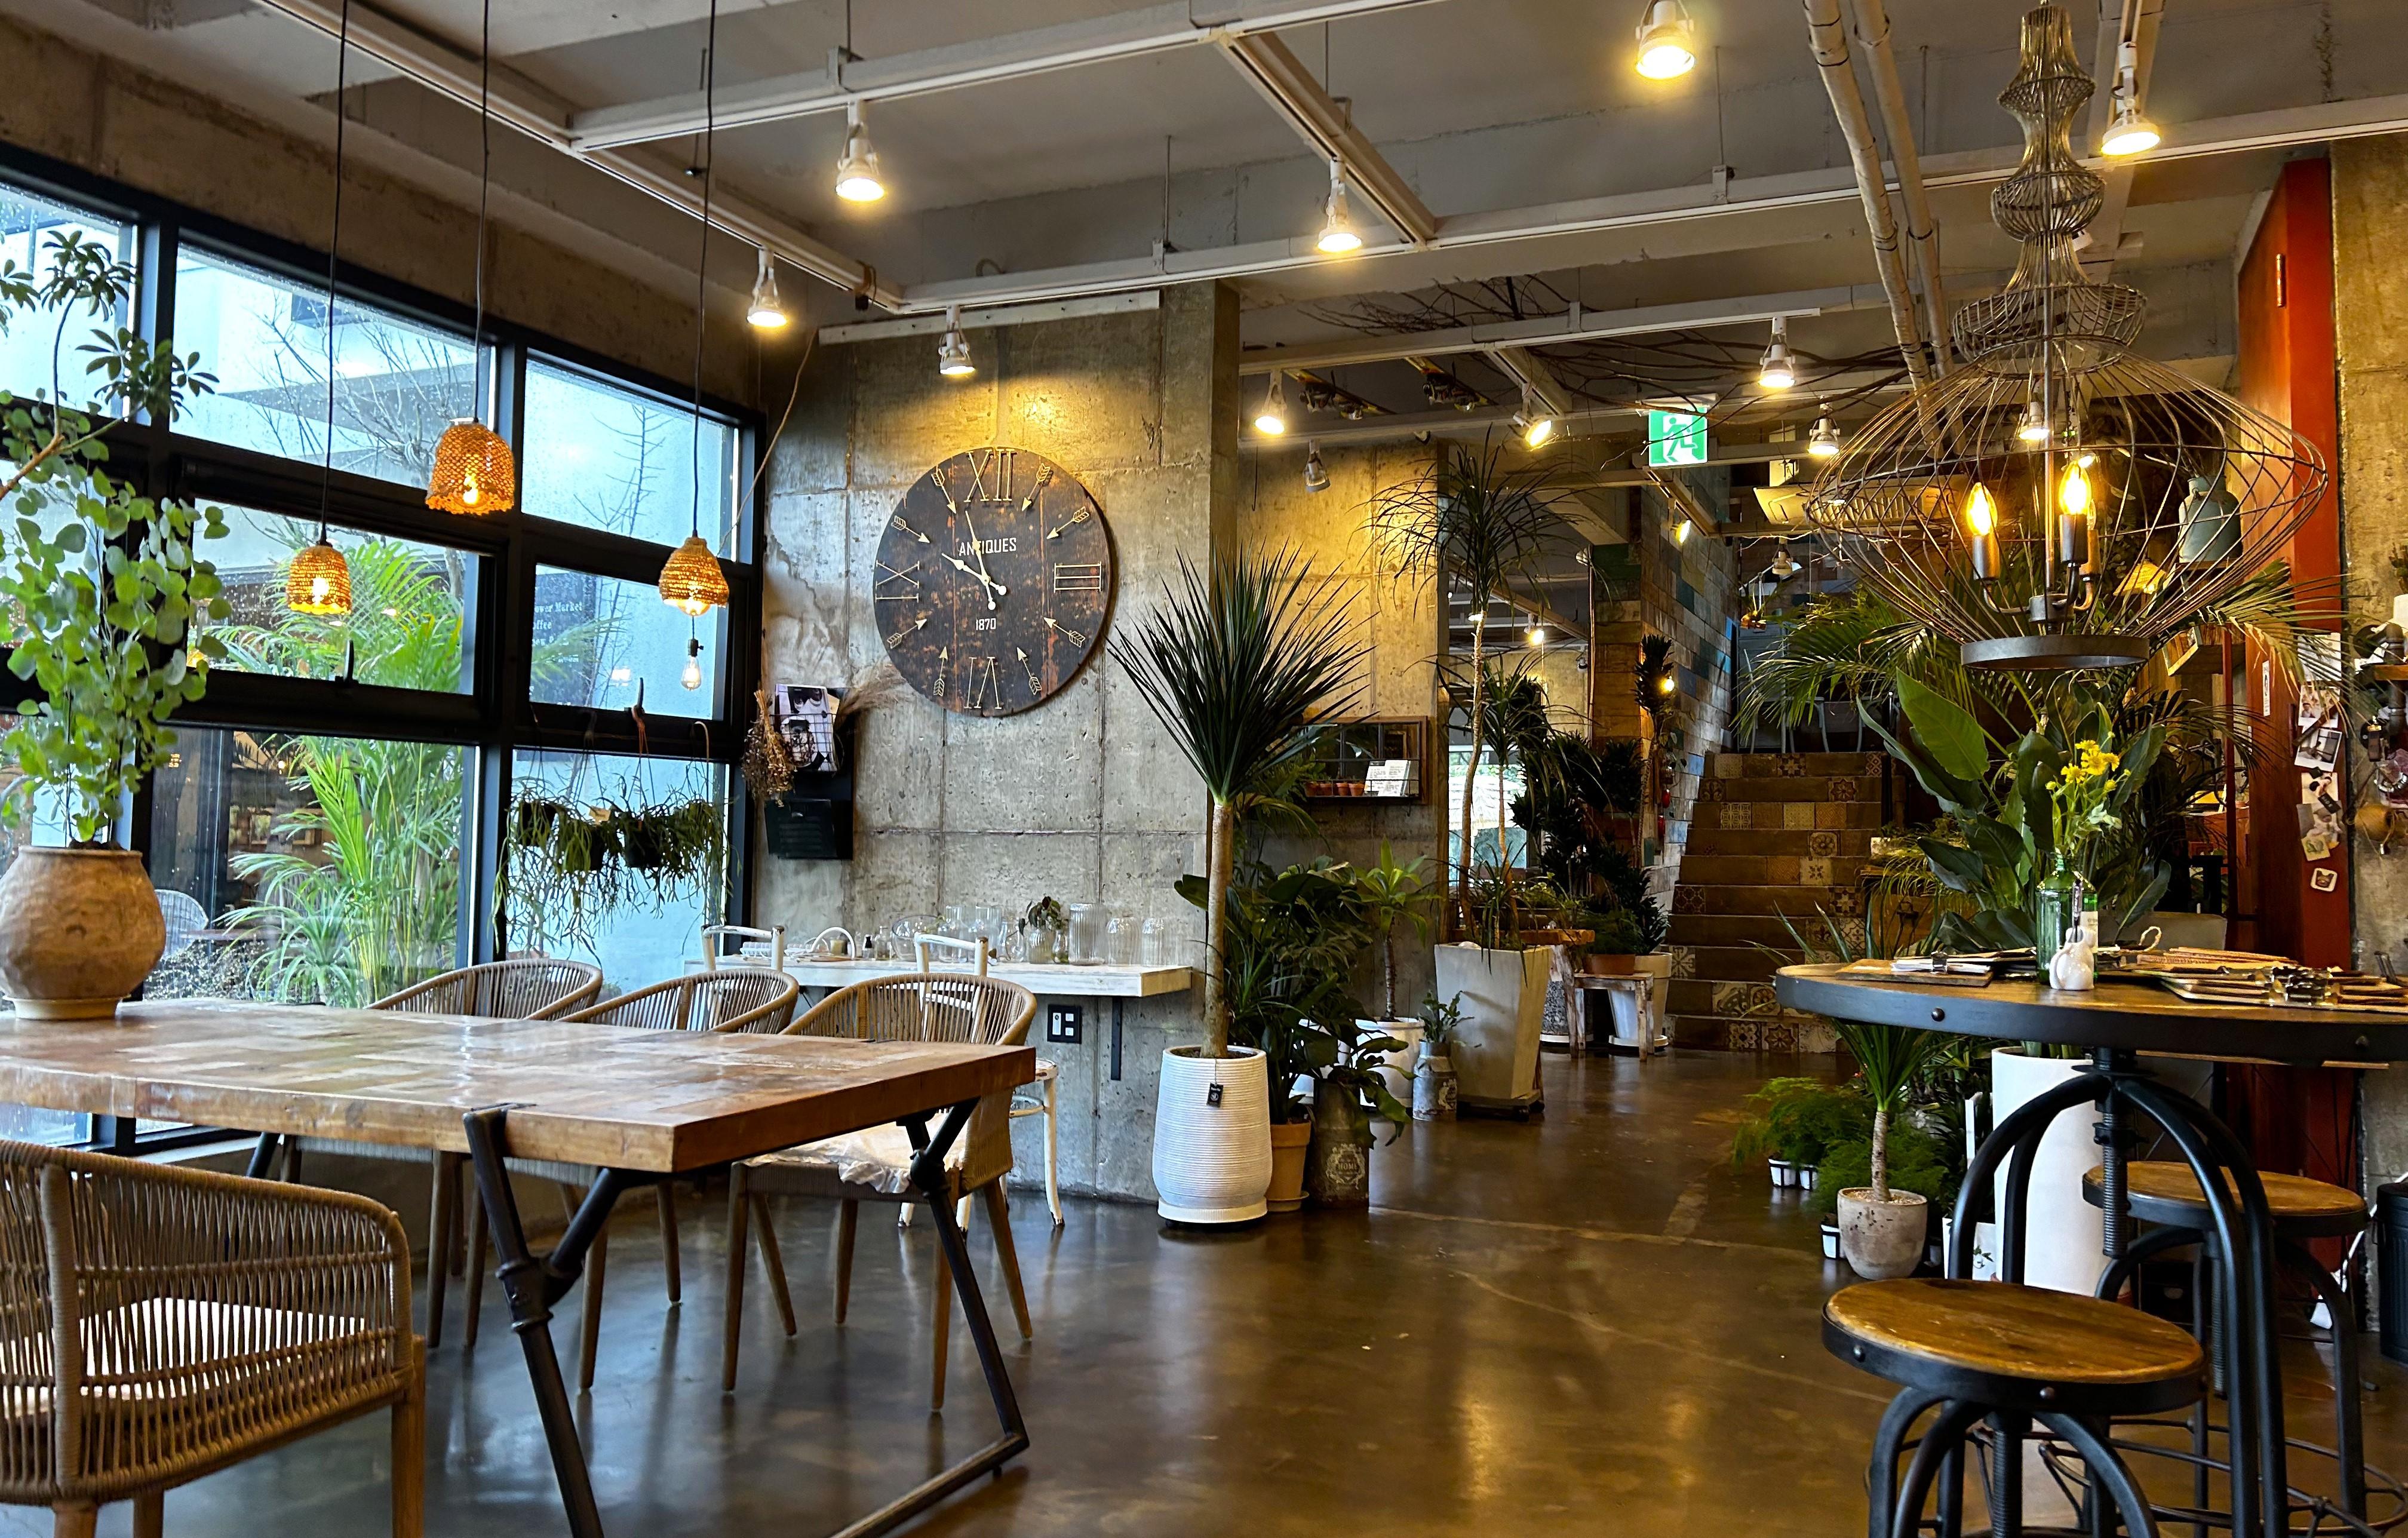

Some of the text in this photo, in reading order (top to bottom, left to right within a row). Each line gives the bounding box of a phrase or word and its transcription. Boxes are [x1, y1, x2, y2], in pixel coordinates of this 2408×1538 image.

[534, 601, 583, 613] ower Market
[975, 618, 997, 631] 1870
